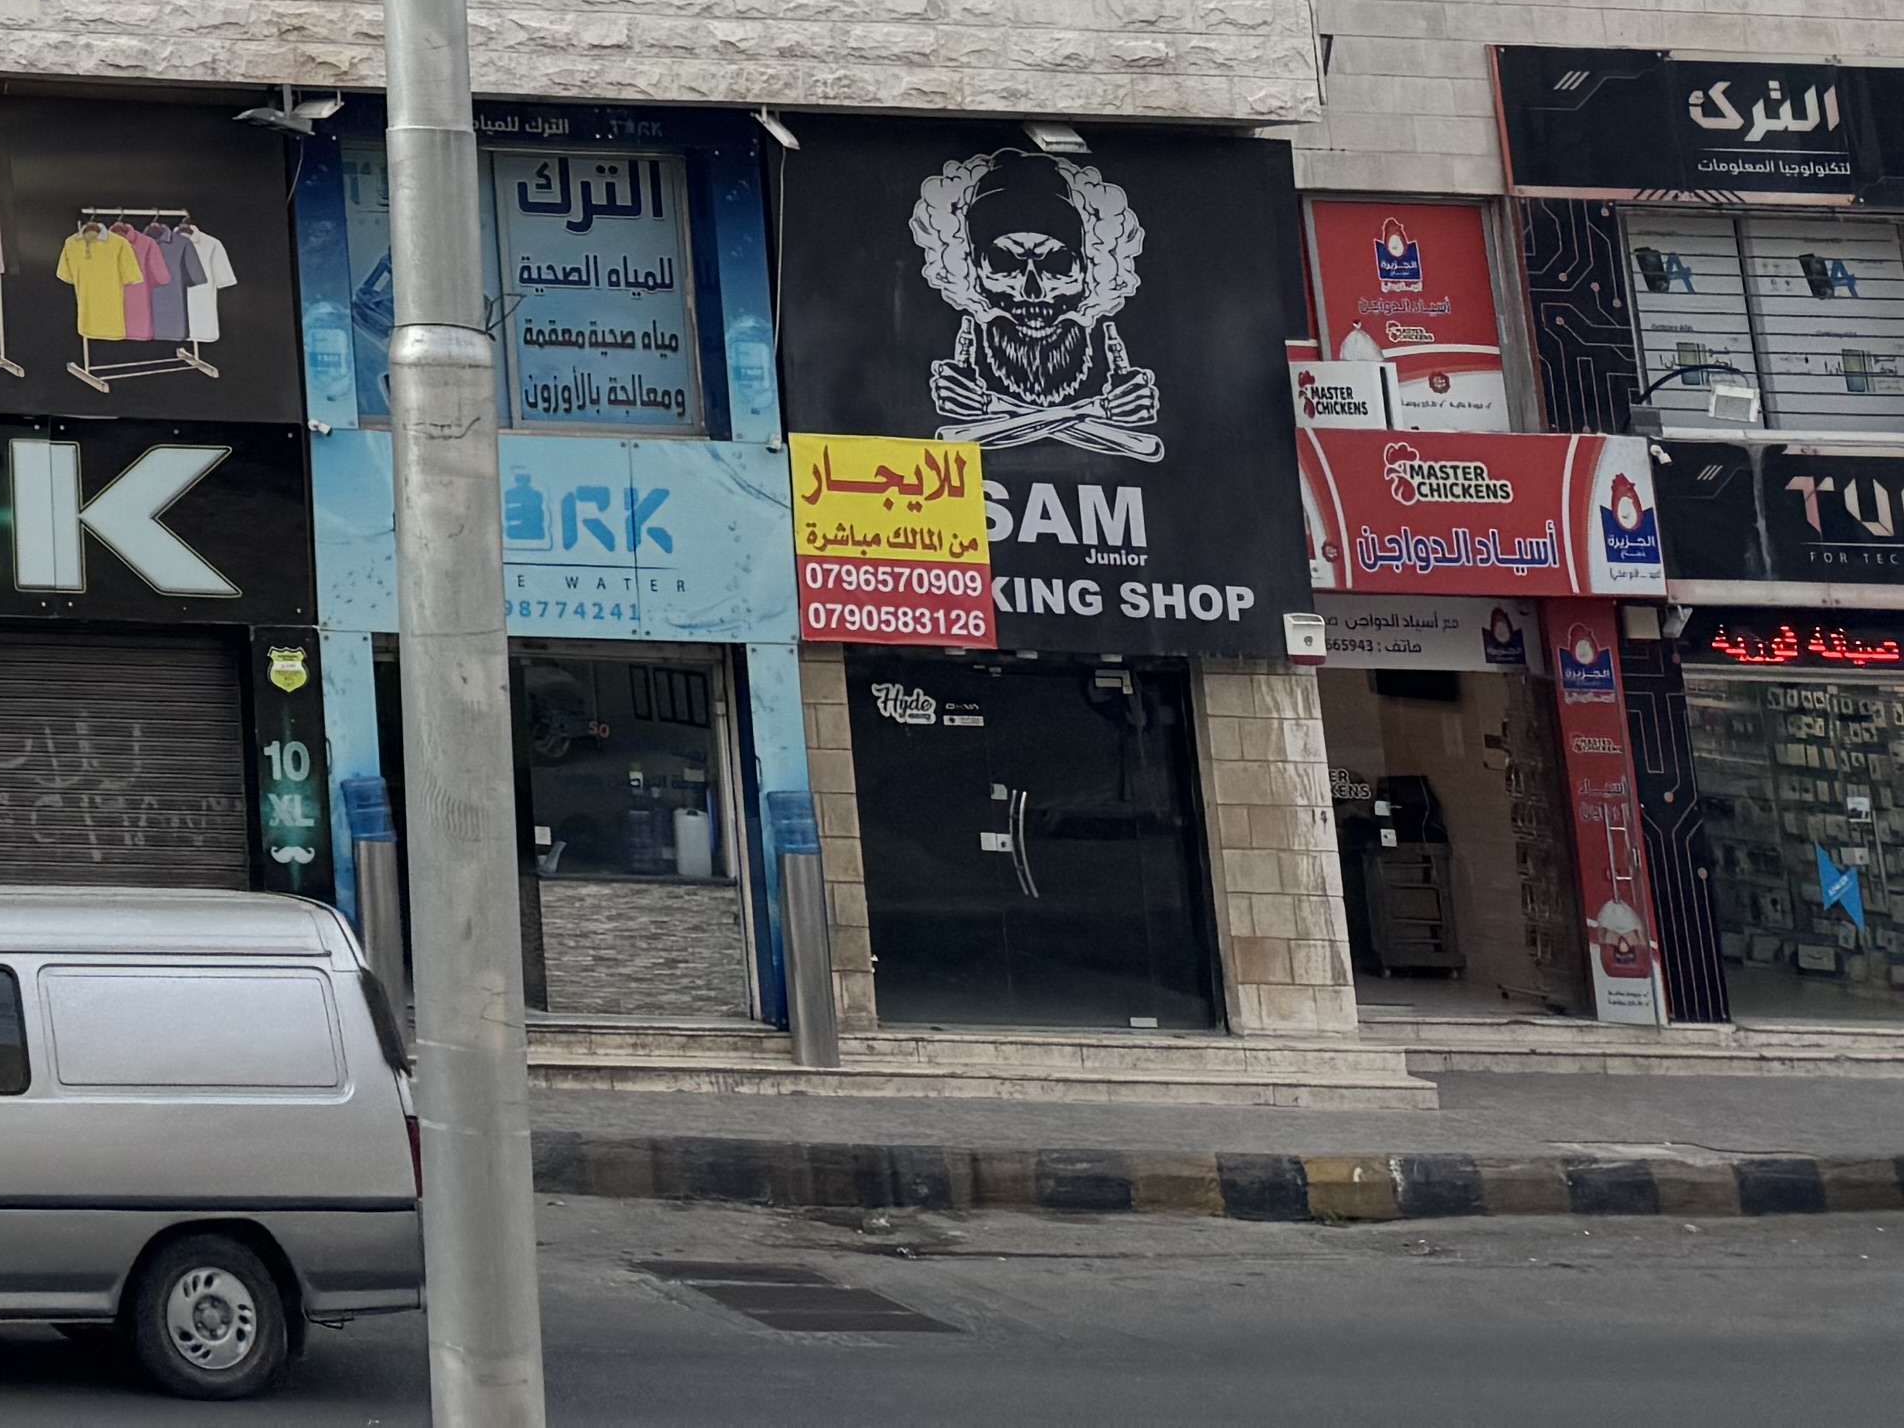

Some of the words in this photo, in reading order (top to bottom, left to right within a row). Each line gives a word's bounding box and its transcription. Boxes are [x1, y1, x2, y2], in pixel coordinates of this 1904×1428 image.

[1689, 80, 1840, 141] الترك
[525, 119, 569, 137] الترك
[1698, 158, 1775, 176] المعلومات
[1780, 160, 1851, 178] لتكنولوجيا
[517, 156, 664, 234] الترك
[519, 254, 600, 294] الصحية
[607, 256, 674, 298] للمياه
[523, 318, 586, 349] معقمة
[589, 321, 635, 357] صحية
[641, 319, 679, 359] مياه
[524, 365, 601, 414] بالأوزون
[607, 374, 686, 417] ومعالجة
[1310, 386, 1354, 401] MASTER
[1315, 400, 1369, 416] CHICKENS
[801, 445, 967, 513] للايجار
[1409, 463, 1486, 482] MASTER
[1416, 482, 1512, 500] CHICKENS
[805, 521, 882, 557] مباشرة
[886, 526, 943, 553] المالك
[949, 532, 979, 559] من
[1357, 525, 1473, 573] الدواجن
[1476, 520, 1560, 576] أسياد
[1085, 548, 1149, 567] Junior
[1810, 551, 1848, 564] FOR
[565, 575, 687, 593] WATER
[805, 562, 983, 597] 0796570909
[504, 599, 641, 622] 98774241
[991, 576, 1104, 616] KING
[1119, 581, 1256, 622] SHOP
[807, 602, 987, 637] 0790583126
[1344, 613, 1400, 631] الدواجن
[1403, 610, 1439, 632] أسياد
[1385, 639, 1422, 653] هاتف
[263, 741, 310, 782] 10
[267, 793, 315, 827] XL
